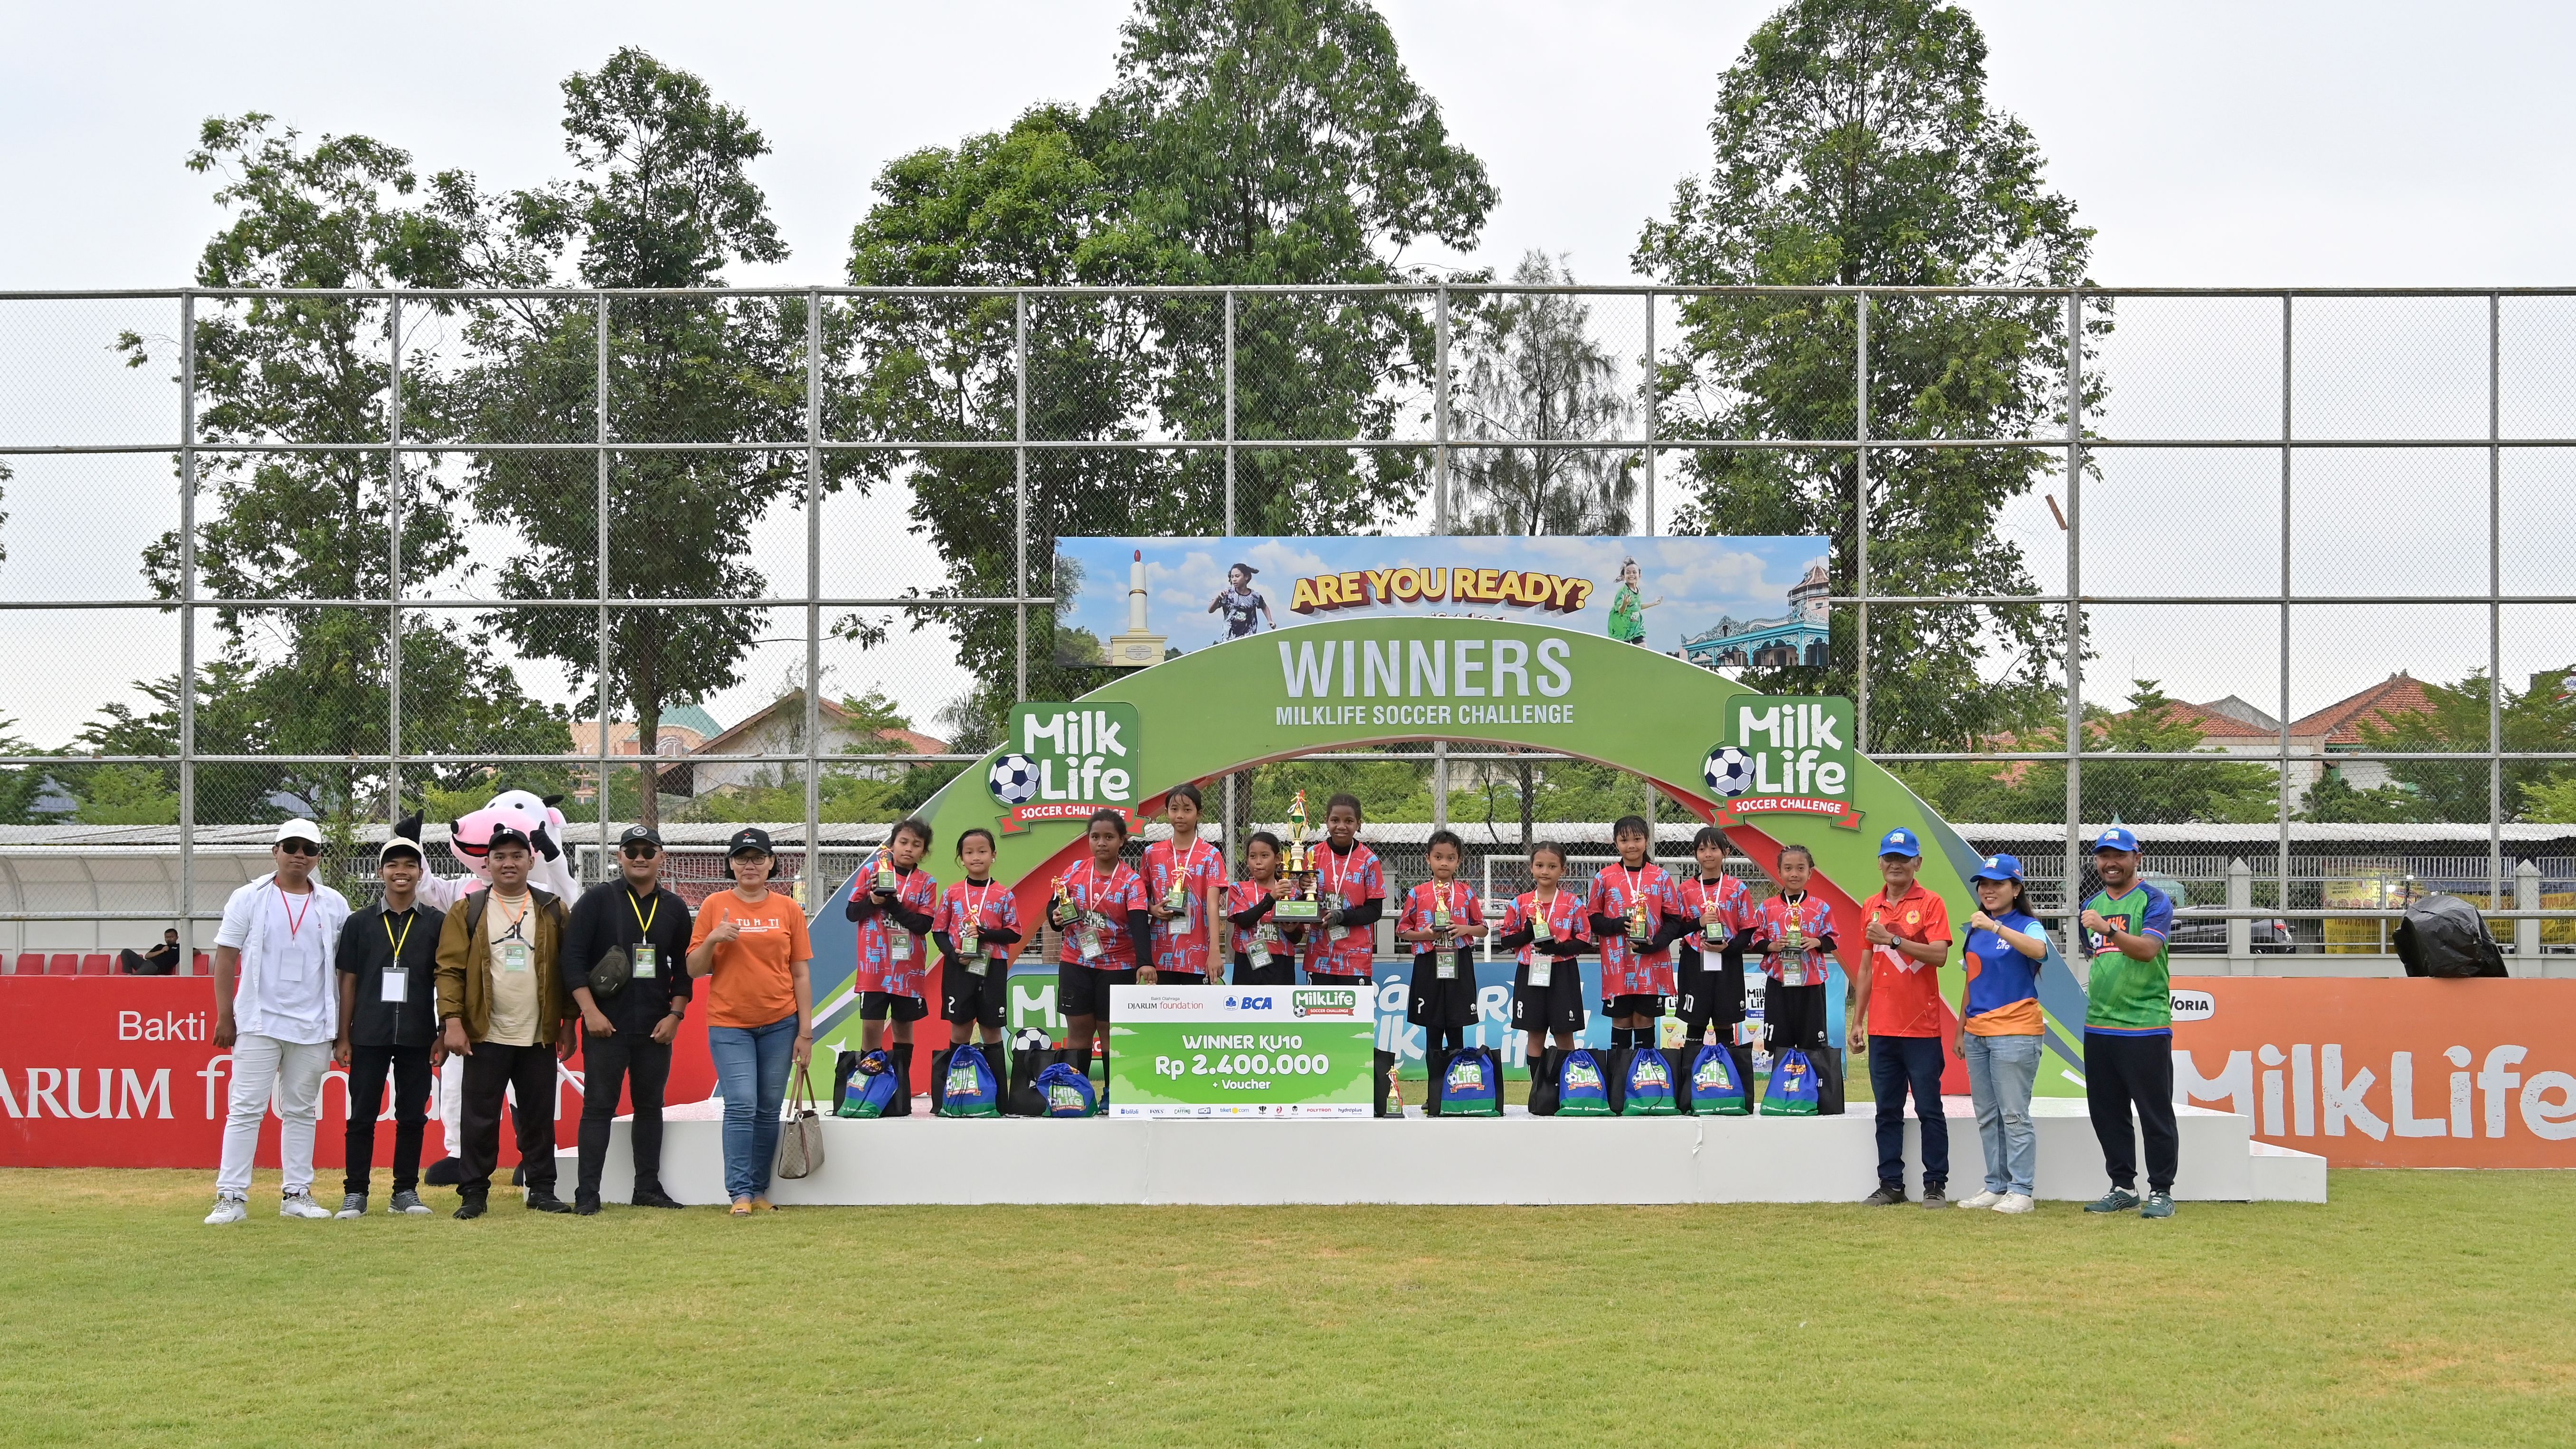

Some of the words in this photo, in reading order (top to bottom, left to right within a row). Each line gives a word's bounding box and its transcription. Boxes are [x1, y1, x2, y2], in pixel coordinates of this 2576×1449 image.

[1290, 572, 1363, 610] ARE
[1365, 568, 1447, 603] YOU
[1453, 568, 1594, 610] READY?
[1278, 638, 1572, 698] WINNERS
[1276, 706, 1366, 725] MILKLIFE
[1373, 705, 1451, 725] SOCCER
[1458, 704, 1573, 724] CHALLENGE
[1024, 710, 1127, 757] Milk
[1739, 704, 1843, 750] Milk
[1041, 756, 1130, 801] Life
[1756, 749, 1846, 795] Life
[1021, 805, 1062, 819] SOCCER
[1736, 799, 1777, 812] SOCCER
[1780, 799, 1842, 813] CHALLENGE
[1086, 910, 1104, 922] Milk
[1260, 924, 1277, 933] Milk
[1262, 932, 1278, 941] Life
[948, 996, 955, 1013] 2
[1160, 1001, 1203, 1009] foundation
[1241, 997, 1272, 1010] BCA
[1296, 992, 1354, 1006] MilkLife
[1683, 994, 1694, 1013] 10
[1751, 999, 1765, 1008] Lif
[1516, 1001, 1524, 1019] 8
[119, 1011, 205, 1041] Bakti
[1764, 1023, 1774, 1041] 11
[1182, 1034, 1255, 1050] WINNER
[1260, 1034, 1303, 1052] KU10
[1155, 1056, 1185, 1080] Rp
[1191, 1053, 1329, 1075] 2.400.000
[1222, 1079, 1272, 1090] Voucher
[1457, 1071, 1480, 1083] Life
[1053, 1087, 1080, 1098] Milk
[1058, 1097, 1082, 1106] Life
